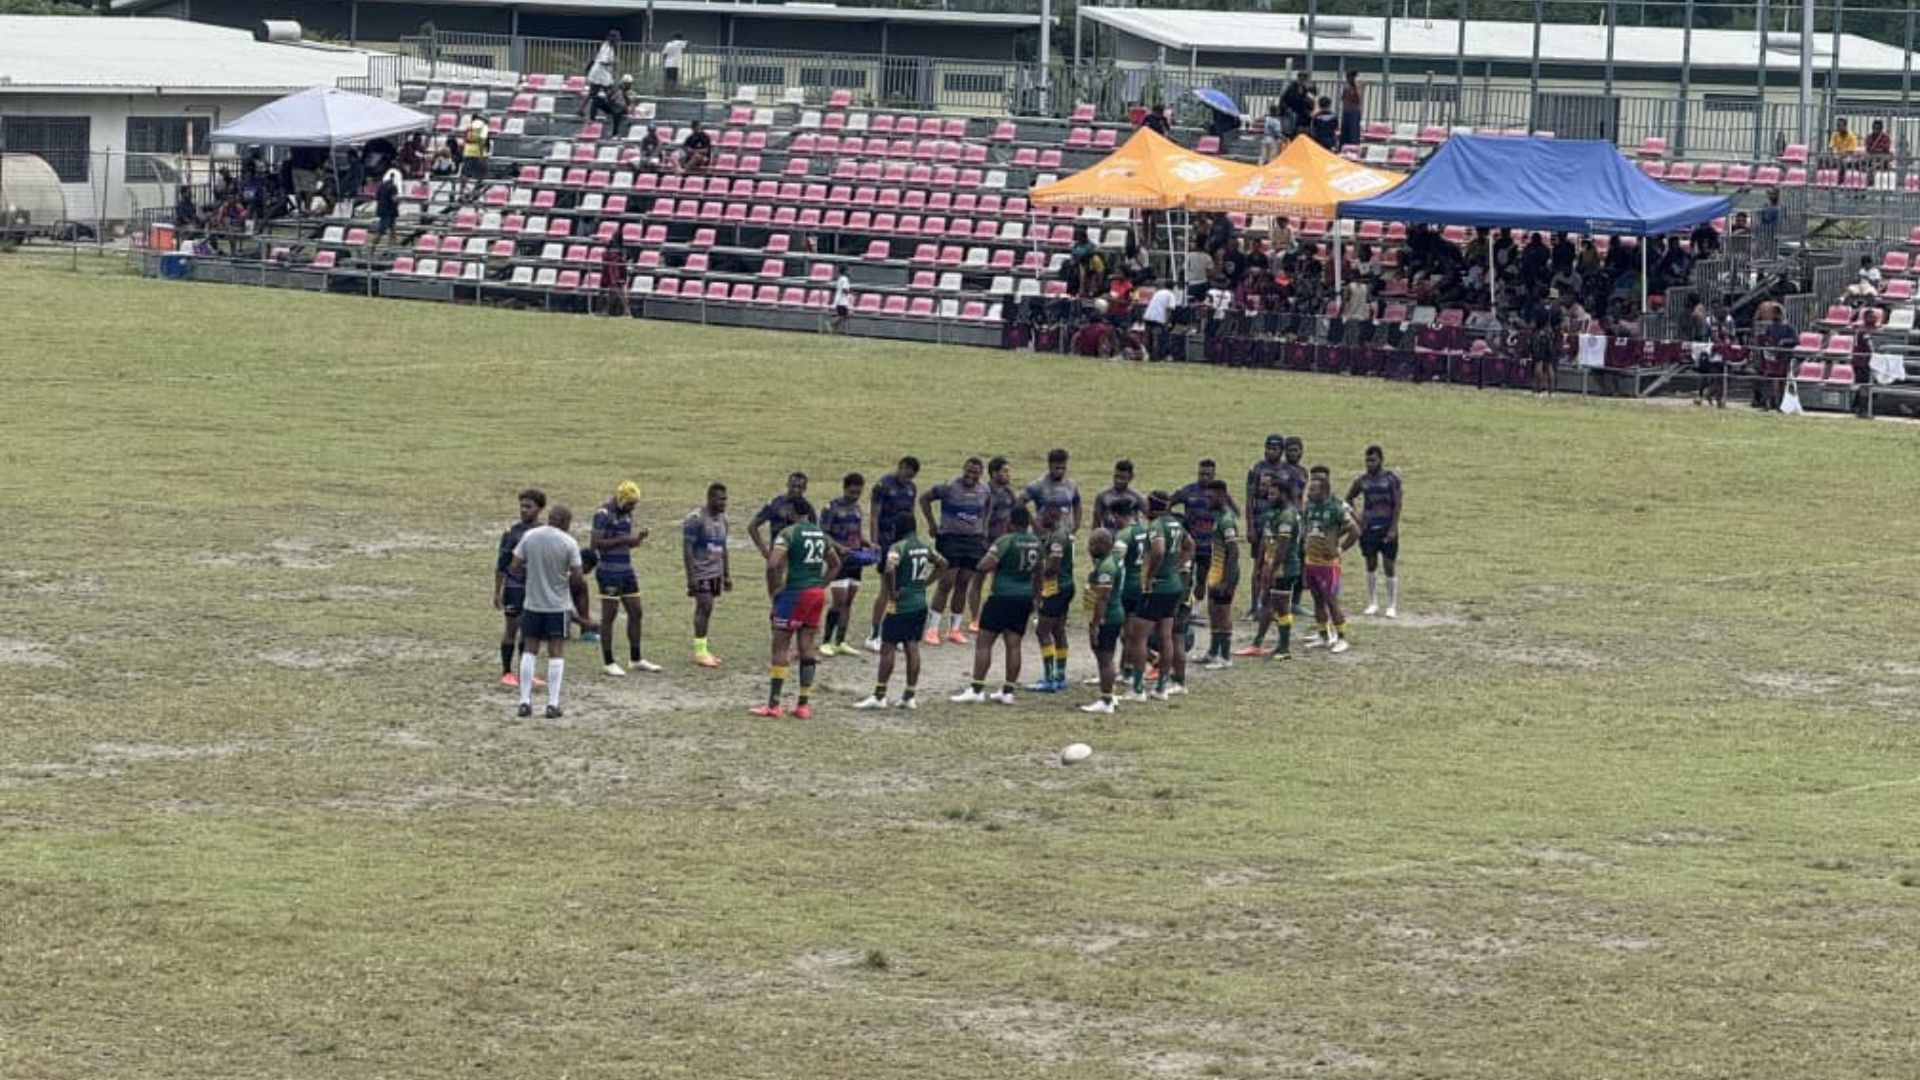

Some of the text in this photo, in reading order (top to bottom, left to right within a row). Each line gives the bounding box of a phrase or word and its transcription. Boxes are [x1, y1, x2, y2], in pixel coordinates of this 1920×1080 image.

[803, 538, 825, 563] 23
[1019, 549, 1039, 571] 19
[911, 556, 928, 581] 12
